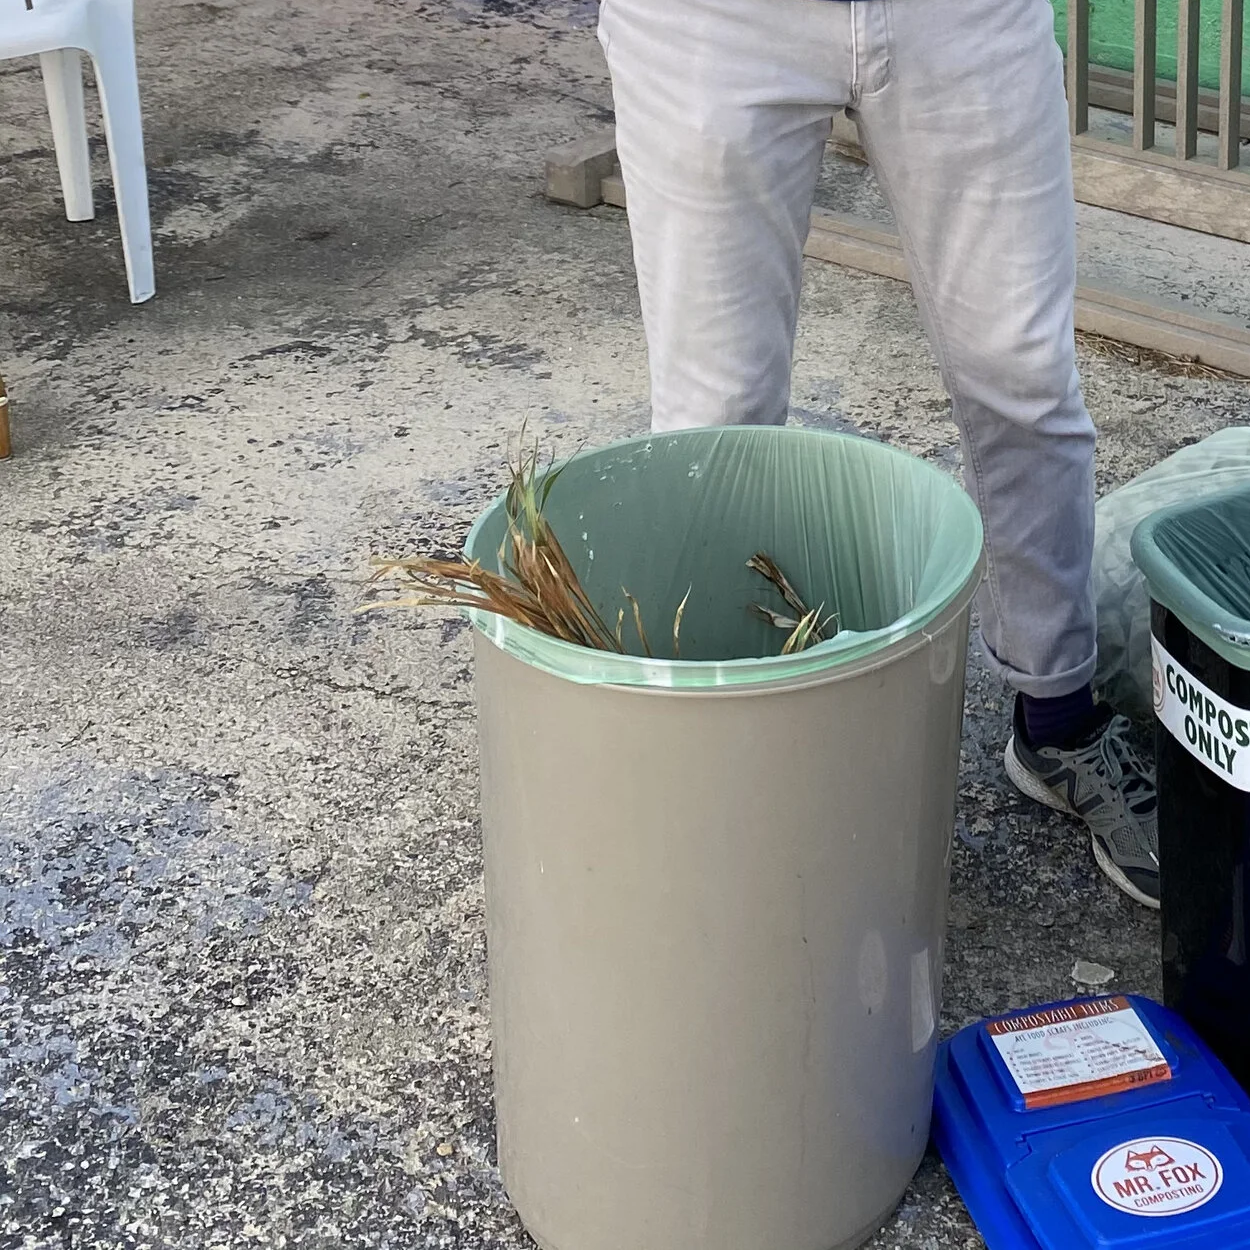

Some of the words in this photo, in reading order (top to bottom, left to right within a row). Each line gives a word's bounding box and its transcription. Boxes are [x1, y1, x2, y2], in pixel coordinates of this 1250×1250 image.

[1184, 714, 1237, 775] ONLY
[1112, 1175, 1161, 1199] MR.
[1158, 1162, 1207, 1188] FOX
[1134, 1183, 1205, 1208] COMPOSTING
